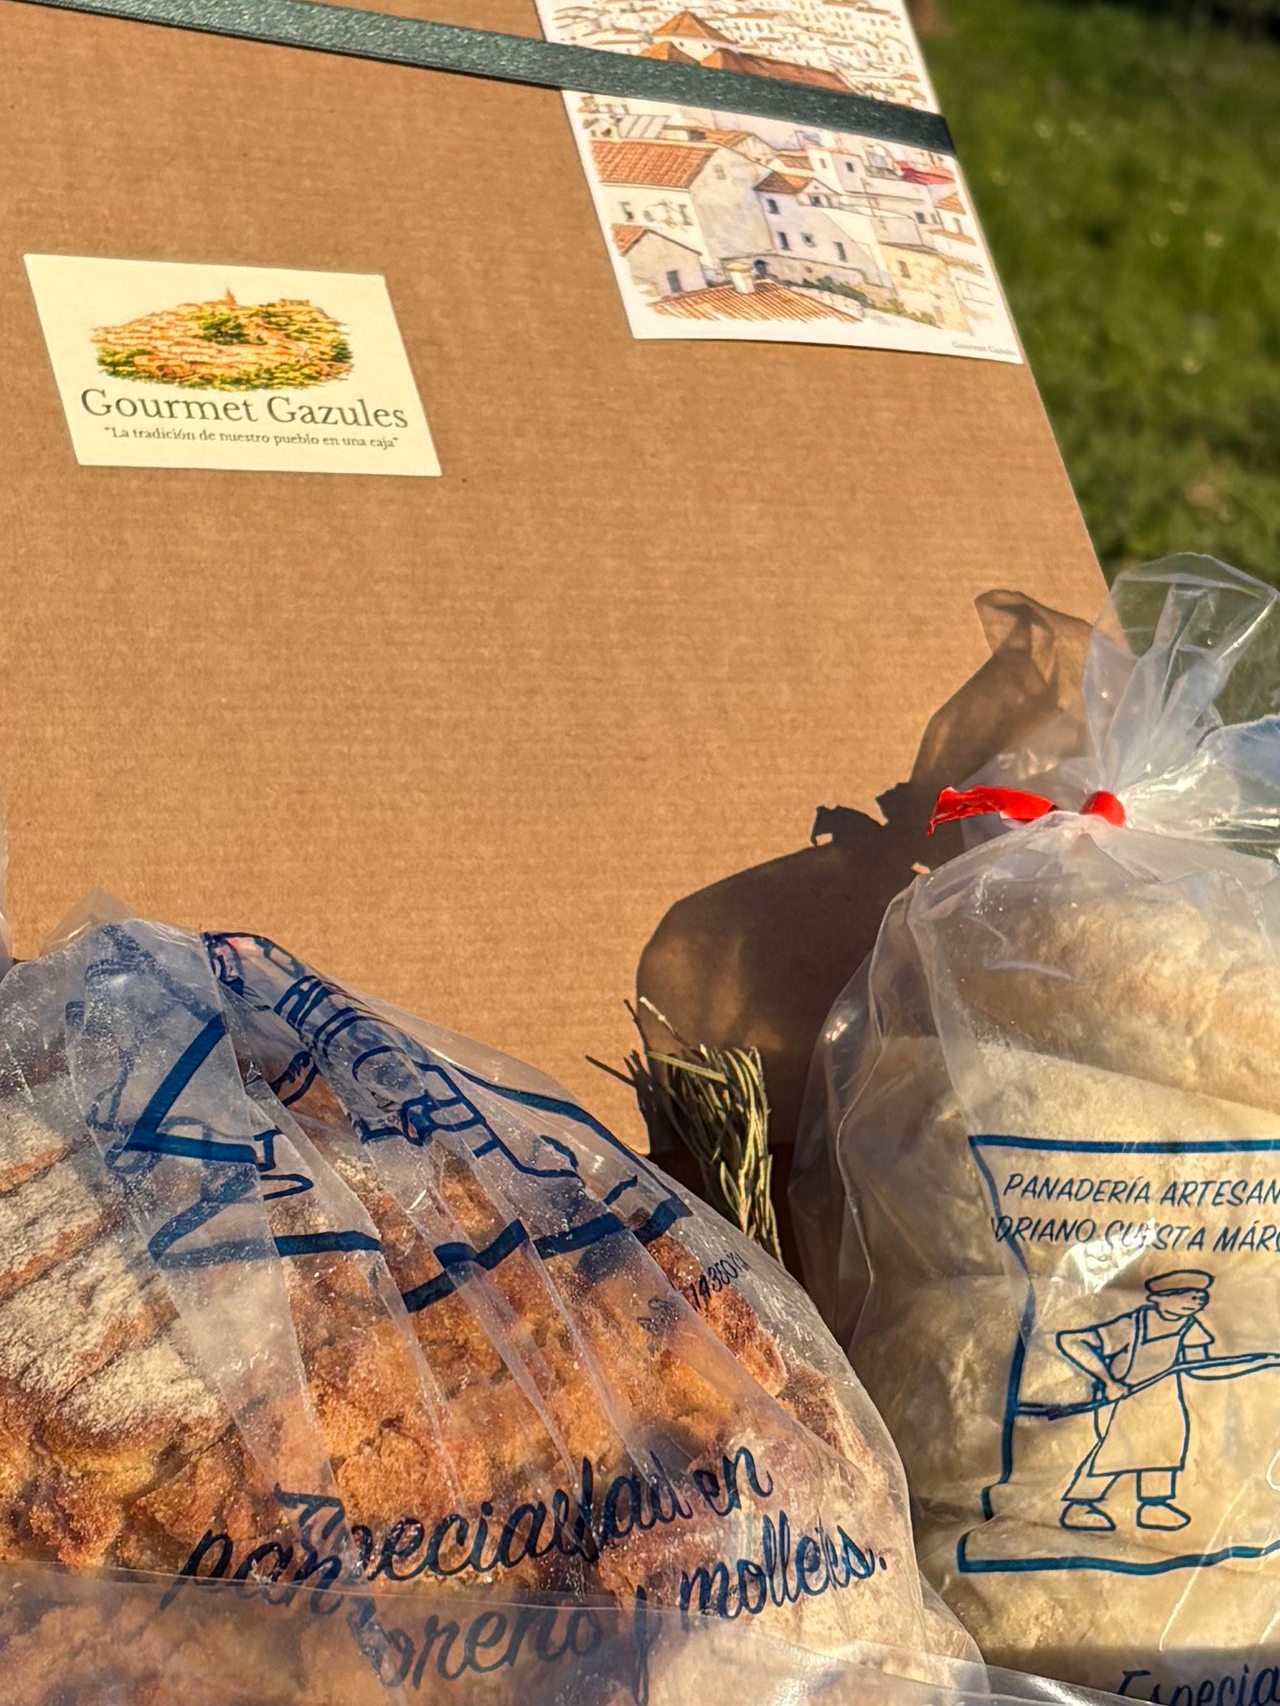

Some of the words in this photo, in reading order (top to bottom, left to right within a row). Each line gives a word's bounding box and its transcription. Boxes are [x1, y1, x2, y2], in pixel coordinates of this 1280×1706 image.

[81, 387, 259, 423] Gourmet
[266, 395, 409, 430] Gazules
[133, 426, 196, 442] tradición
[198, 428, 217, 442] de
[219, 431, 270, 444] nuestro
[274, 431, 320, 448] pueblo
[322, 437, 340, 447] en
[342, 437, 367, 448] una
[1003, 1172, 1151, 1205] PANADERÍA
